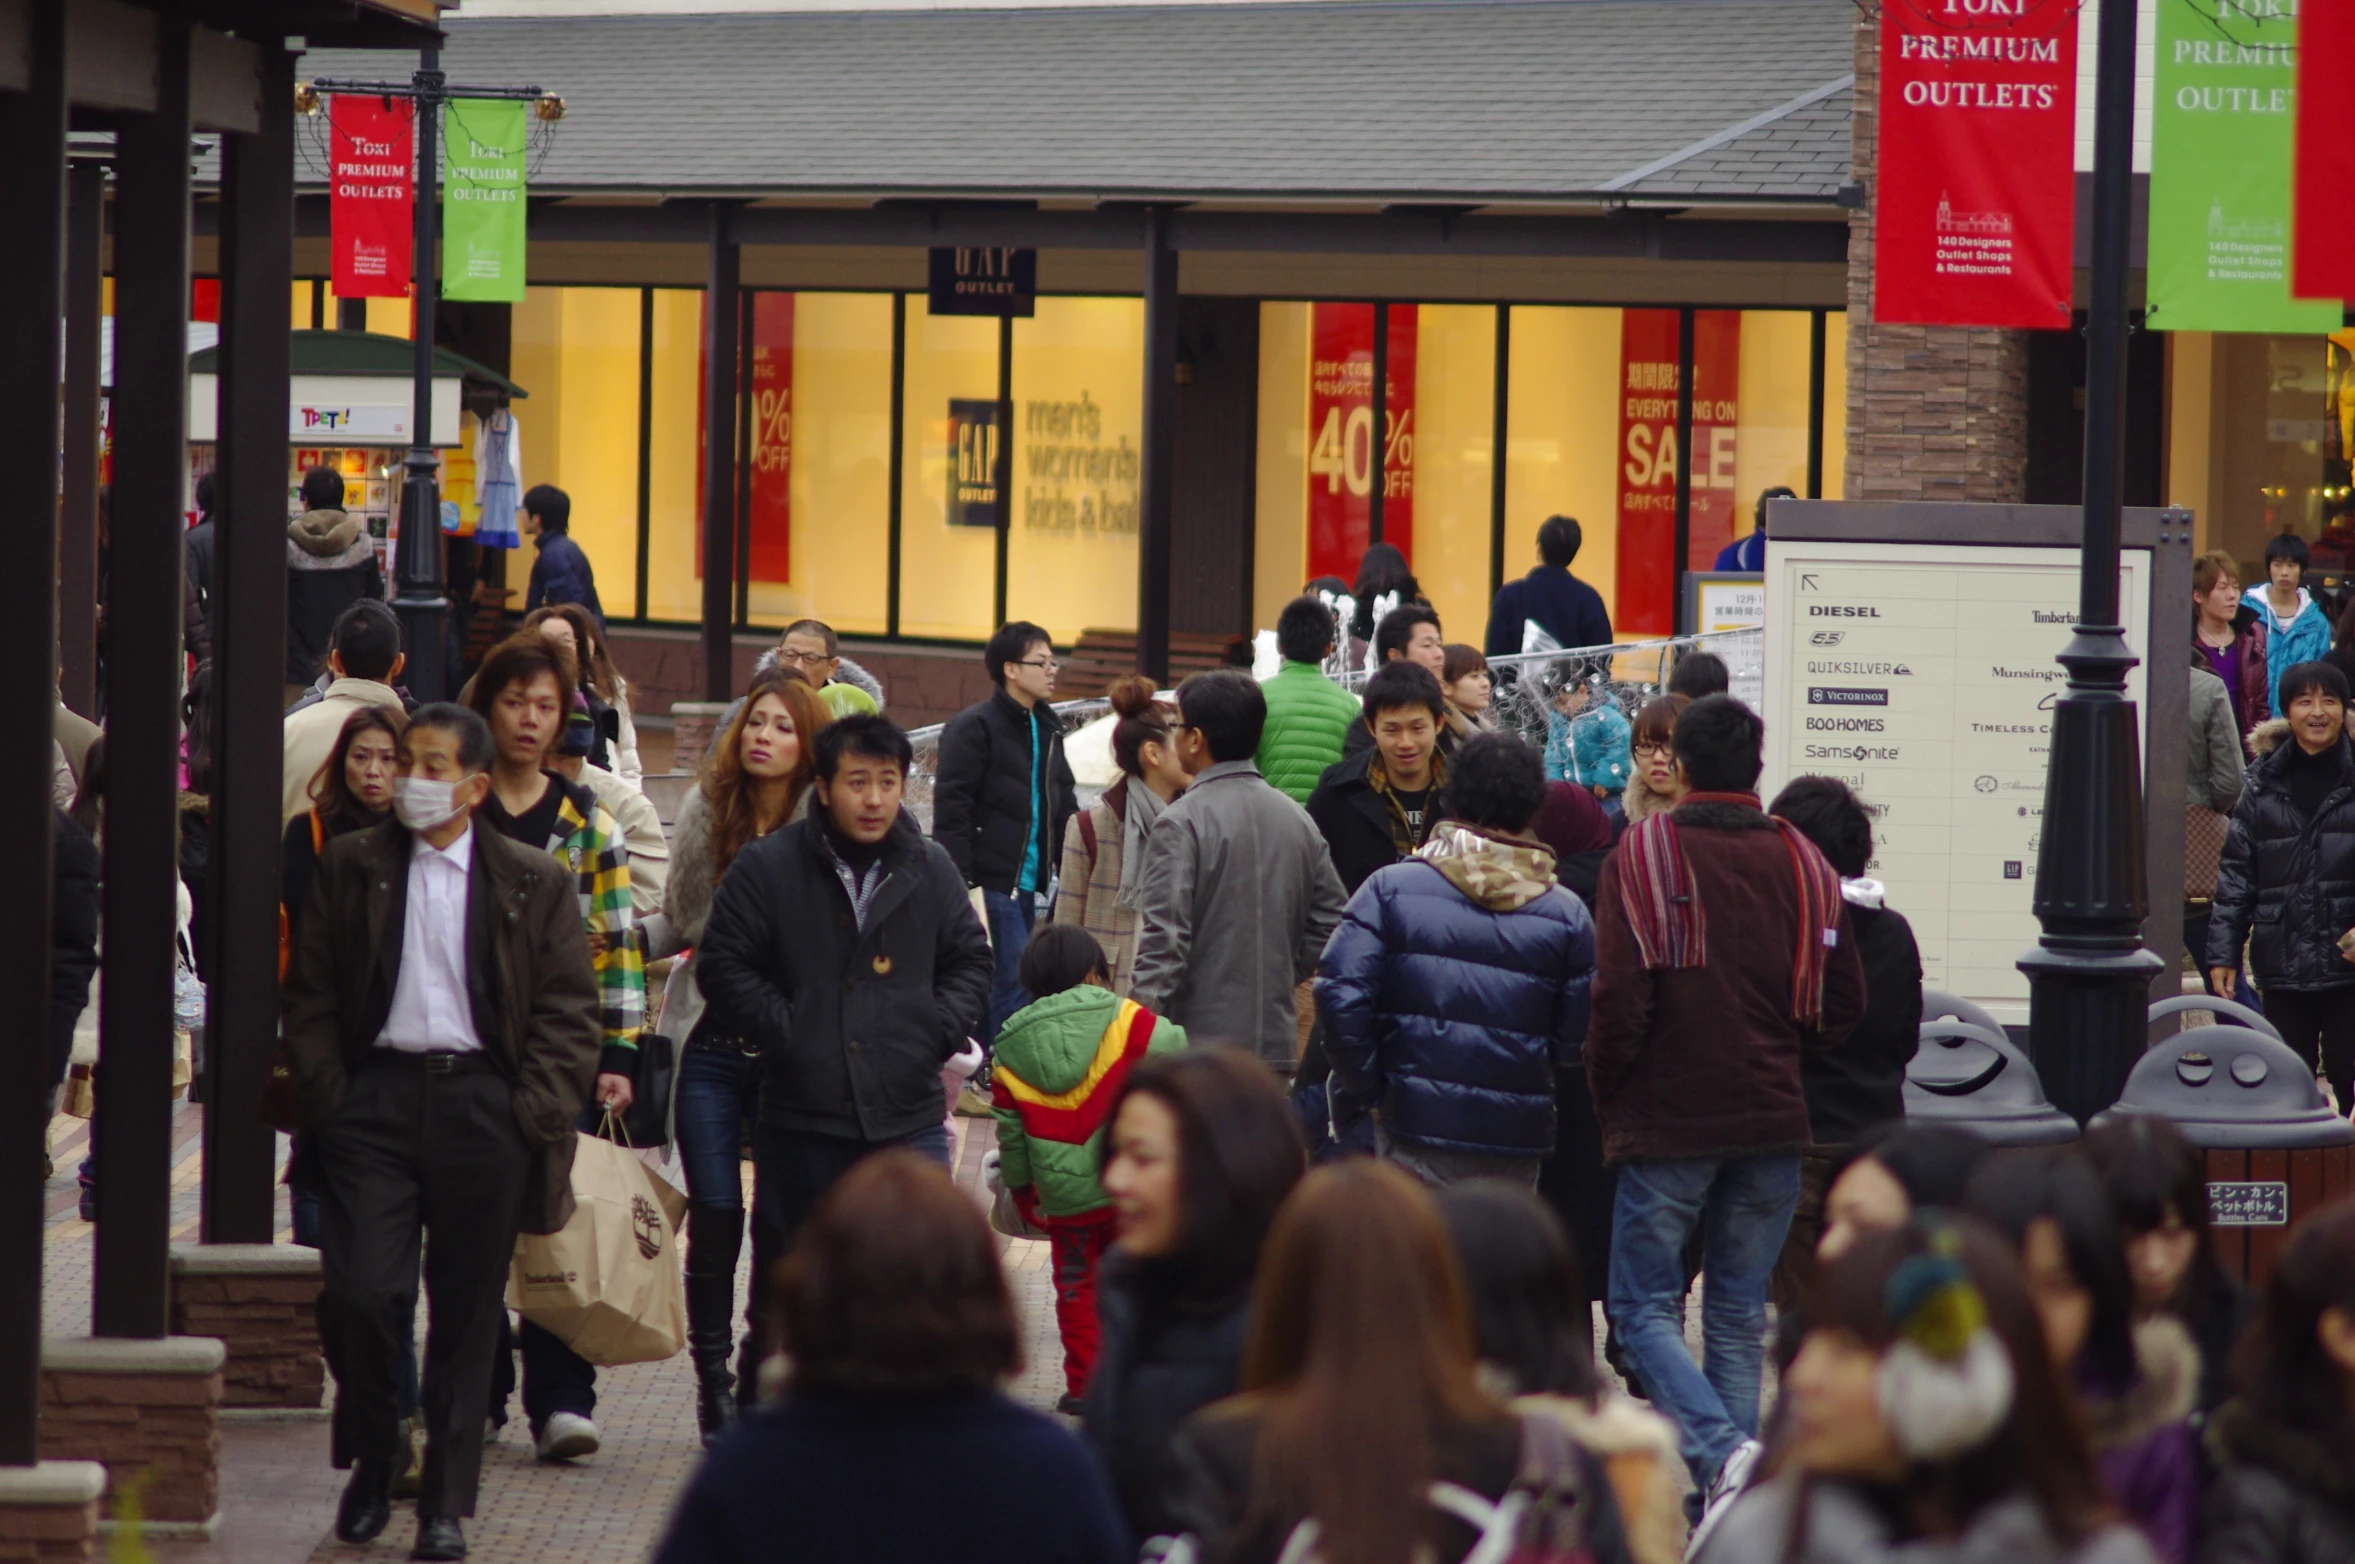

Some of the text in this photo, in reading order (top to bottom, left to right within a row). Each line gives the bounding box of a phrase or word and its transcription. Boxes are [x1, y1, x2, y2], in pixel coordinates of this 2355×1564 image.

[1901, 35, 2058, 62] PREMIUM
[1904, 81, 2054, 108] OUTLETS
[338, 163, 404, 177] PREMIUM
[453, 167, 517, 180] PREMIUM
[339, 185, 402, 199] OUTLETS
[454, 188, 516, 201] OUTLETS
[1938, 236, 2012, 249] 140 Designers
[1936, 250, 2012, 262] Outlet Shops
[2208, 256, 2282, 268] Outlet Shops
[1936, 263, 2011, 274] & Restaurants
[2218, 268, 2282, 280] Restaurants
[955, 282, 1014, 294] OUTLET
[1627, 362, 1698, 391] 期間限!
[1026, 389, 1100, 436] men's
[1626, 398, 1736, 421] EVERYTNG ON
[758, 445, 790, 472] OFF
[958, 422, 999, 485] GAP
[1624, 423, 1736, 489] SALE
[958, 487, 998, 503] OUTLET
[1809, 605, 1881, 618] DIESEL
[1807, 661, 1891, 675] QUIKSILVER
[1826, 691, 1885, 702] VICTORINOX
[1971, 723, 2035, 733] TIMELESS
[1805, 744, 1899, 761] Samsonite
[2210, 1200, 2276, 1213] ペットボトル
